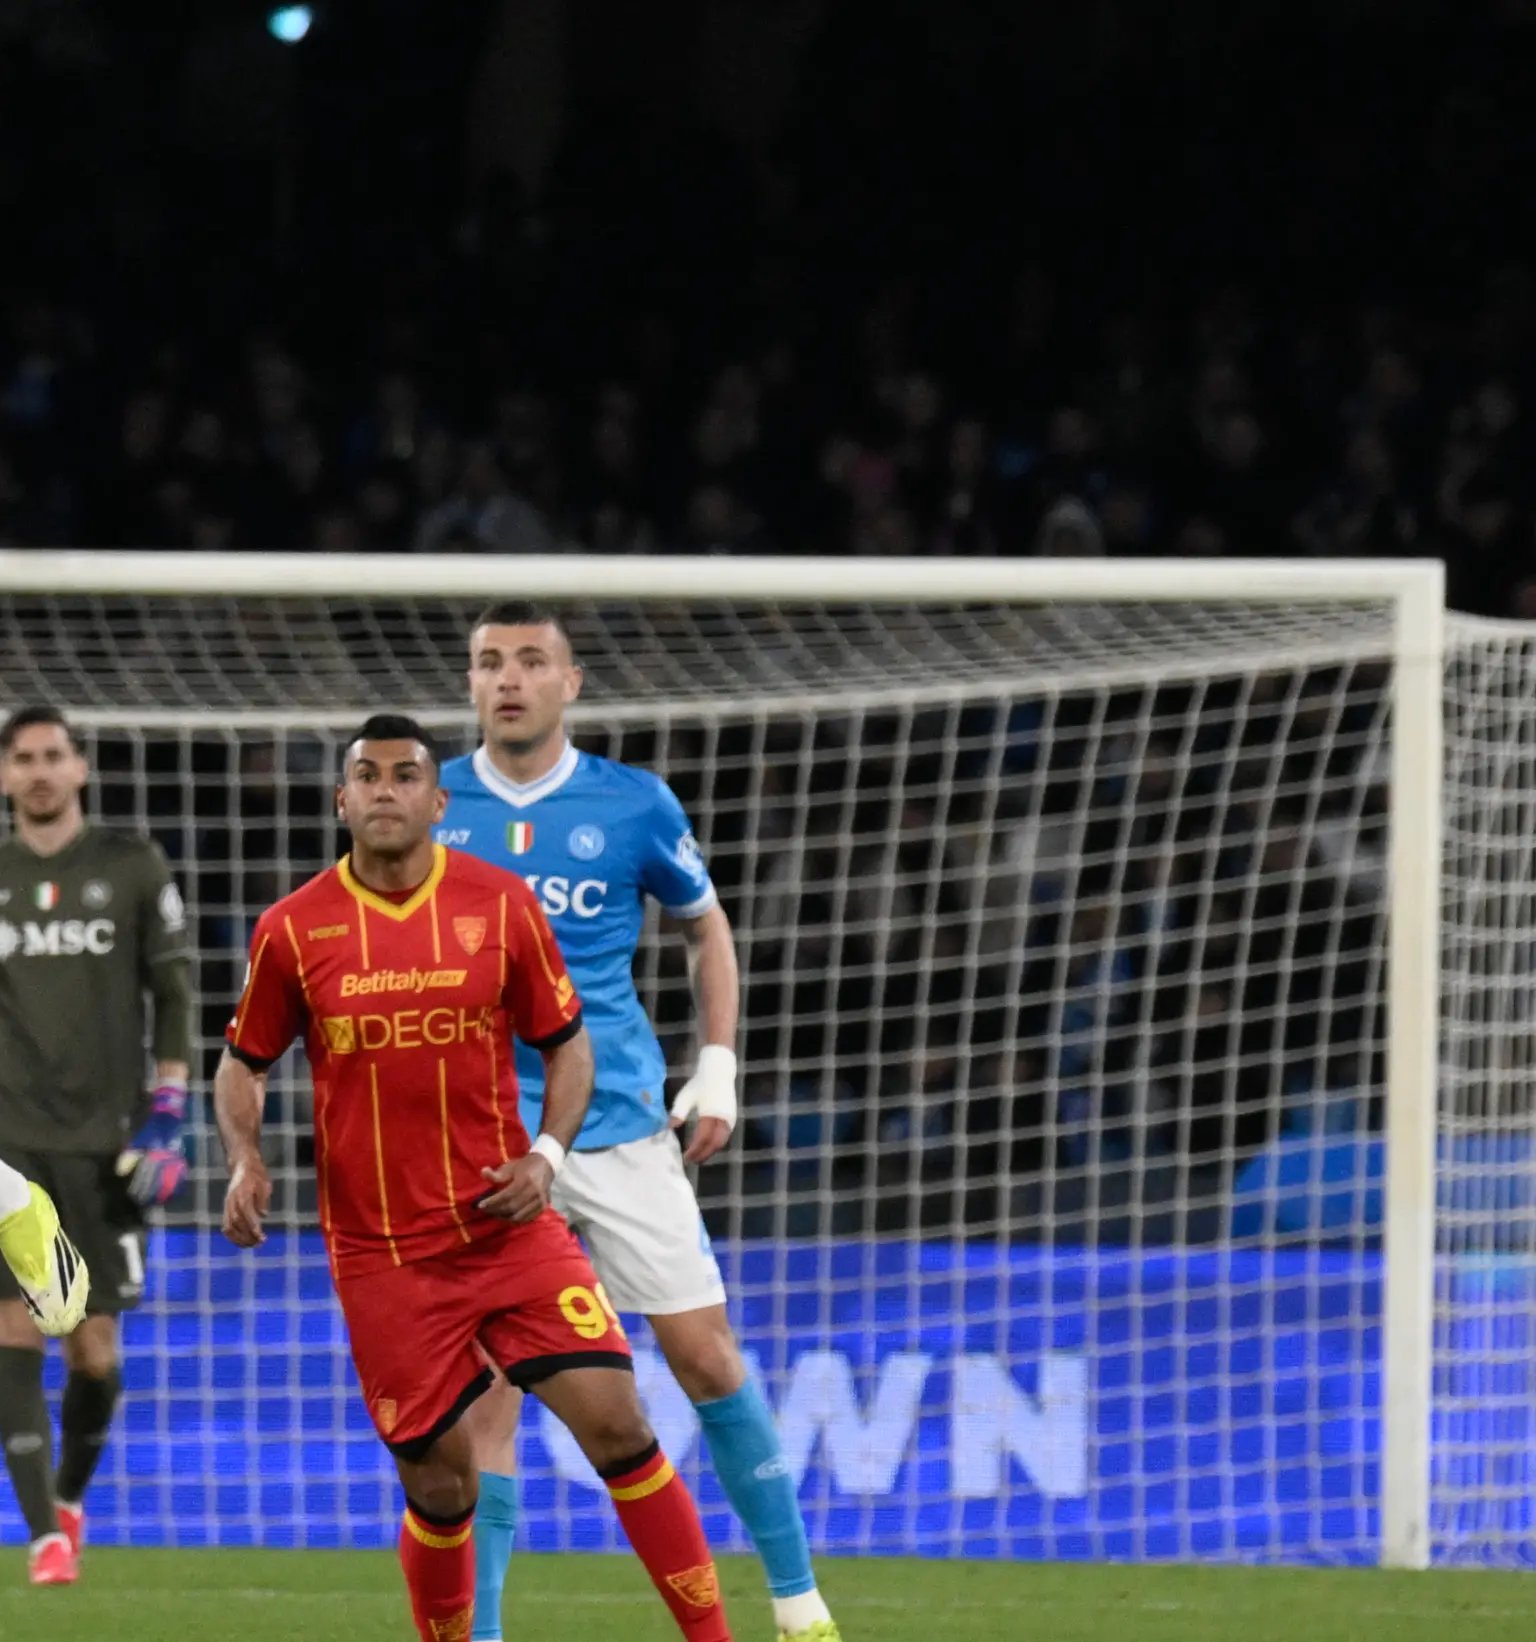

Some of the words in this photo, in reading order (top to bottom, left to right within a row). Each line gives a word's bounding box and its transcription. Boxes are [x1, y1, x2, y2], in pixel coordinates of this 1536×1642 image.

[435, 829, 472, 845] EA7
[525, 874, 609, 919] SC
[22, 918, 116, 957] MSC
[340, 967, 430, 997] Betitaly
[118, 1232, 145, 1286] 1
[558, 1282, 628, 1340] 9
